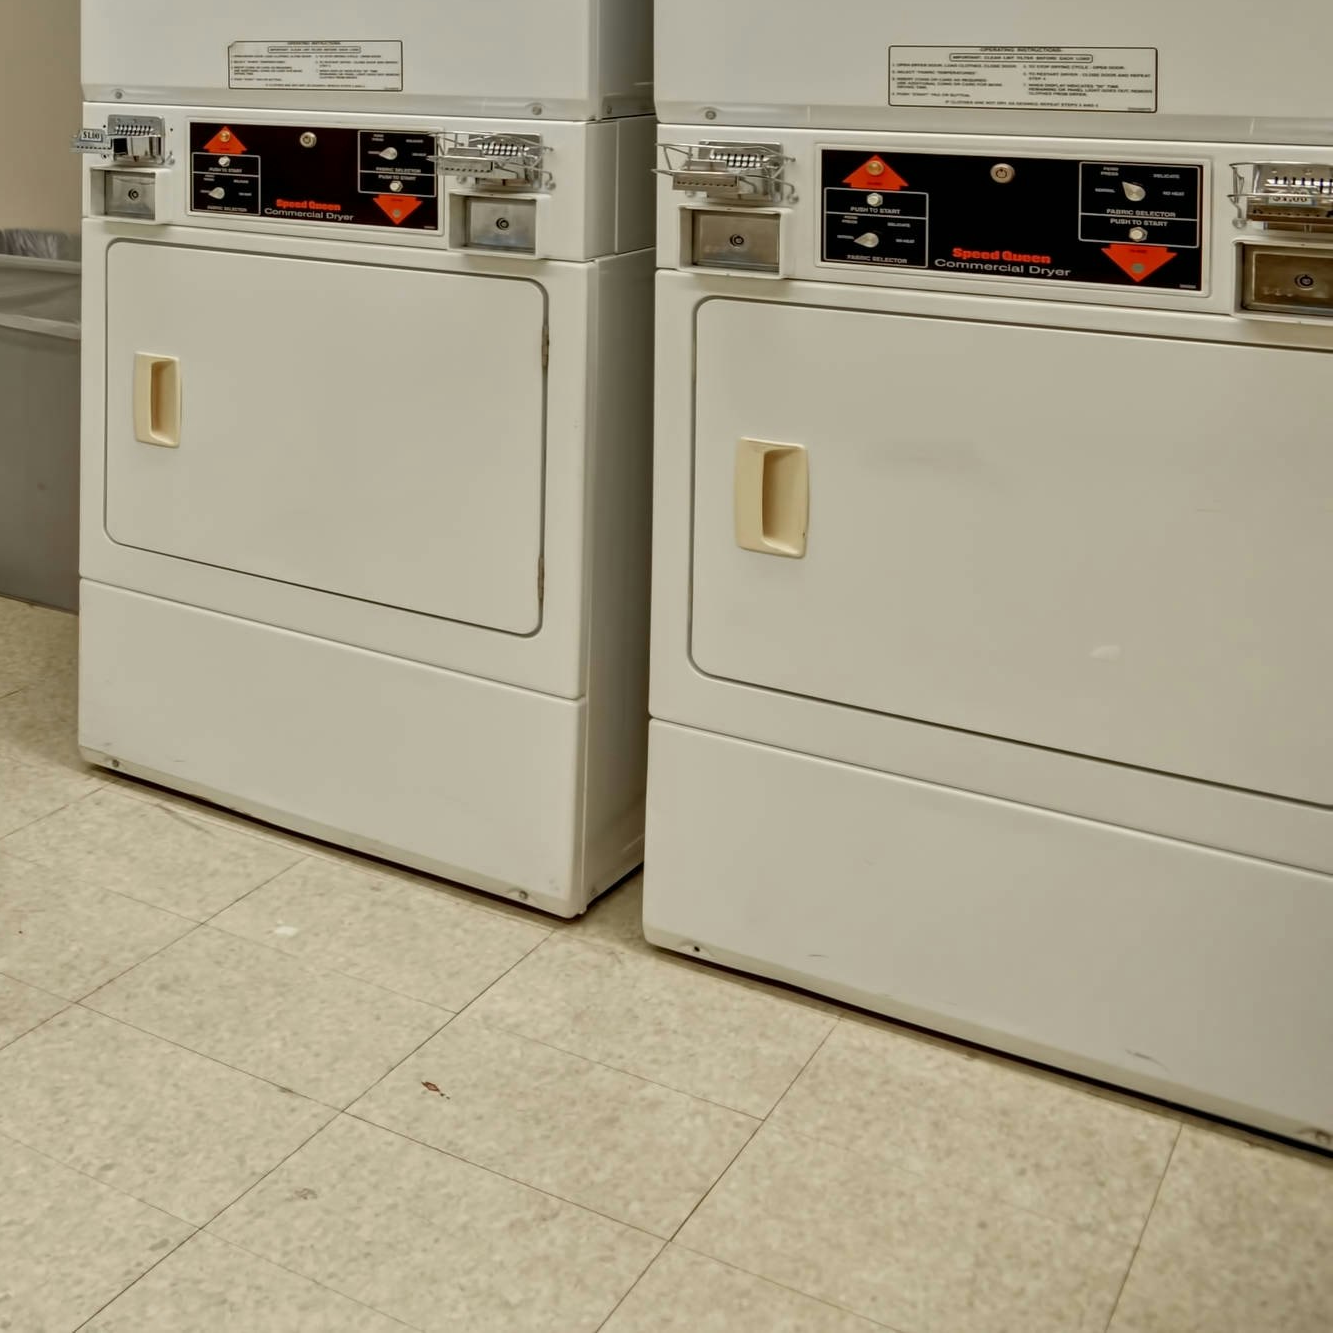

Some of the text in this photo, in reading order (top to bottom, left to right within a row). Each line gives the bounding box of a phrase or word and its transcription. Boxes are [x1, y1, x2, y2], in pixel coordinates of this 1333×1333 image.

[264, 207, 354, 221] Commercial Dryer
[953, 247, 1051, 264] Speed Queen
[934, 258, 1072, 277] Commercial Dryer
